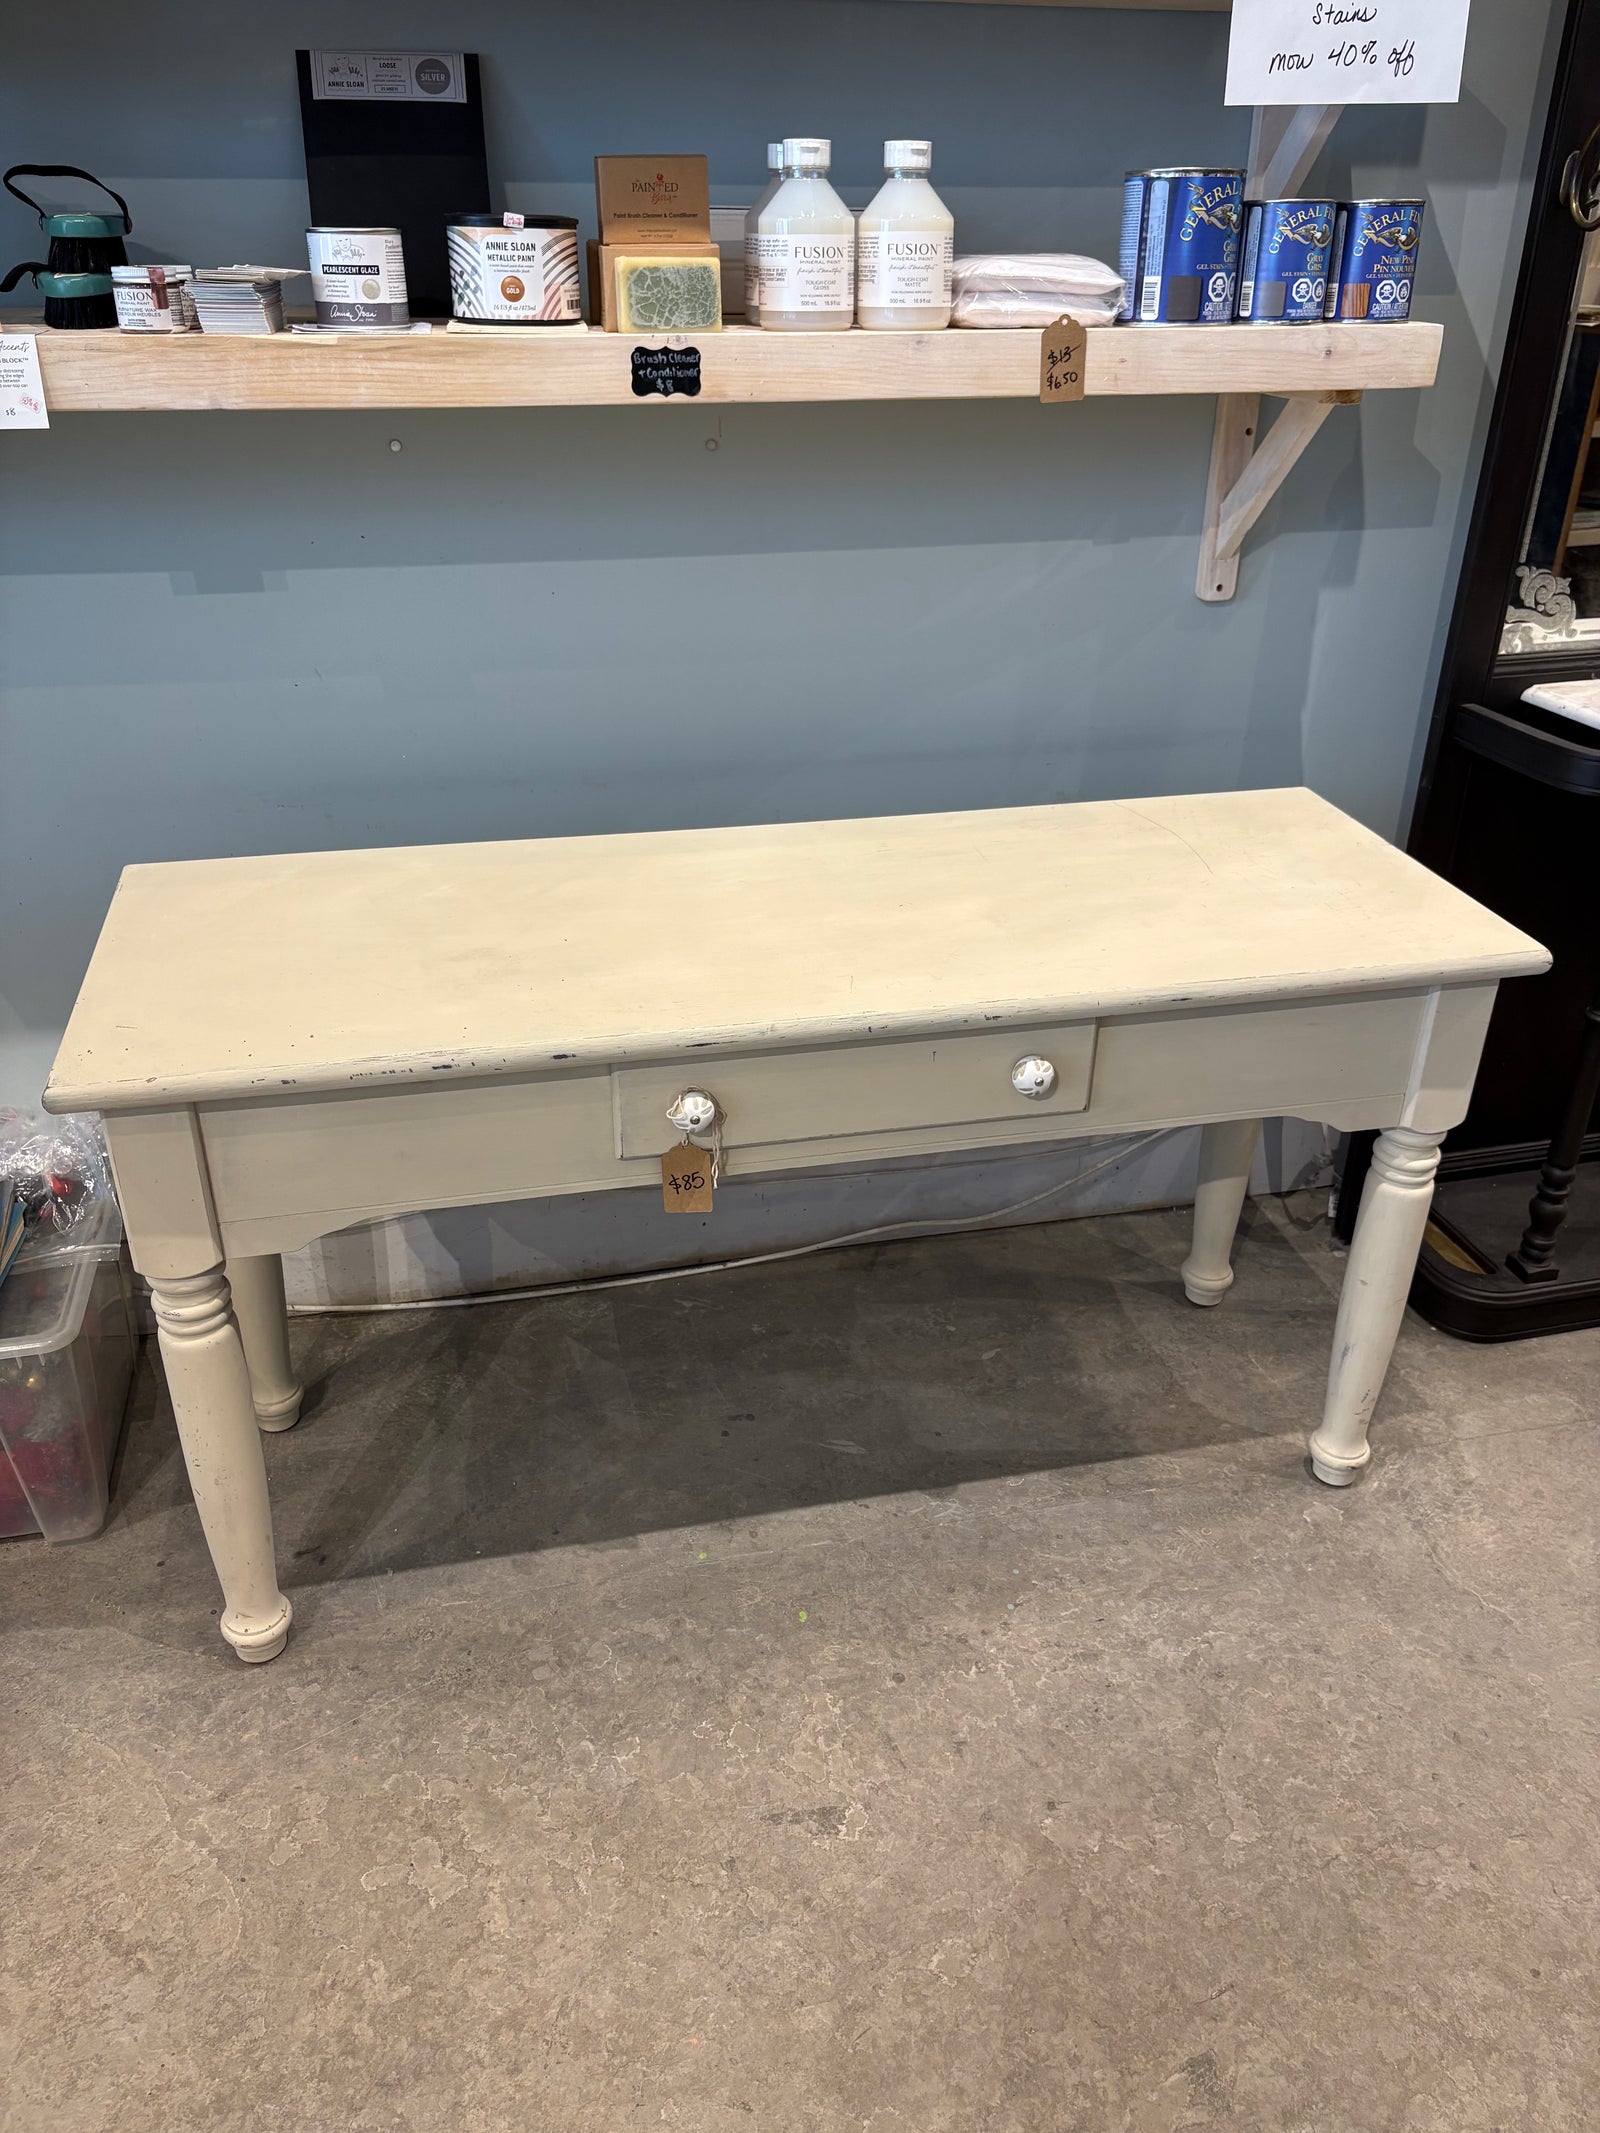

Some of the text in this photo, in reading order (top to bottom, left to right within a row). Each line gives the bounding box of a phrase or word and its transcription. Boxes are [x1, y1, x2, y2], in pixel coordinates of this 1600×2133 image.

[1312, 3, 1377, 25] Stains
[1328, 41, 1377, 67] 40%
[1387, 39, 1415, 77] off
[421, 73, 446, 81] SILVER
[1180, 181, 1239, 242] GENERAL
[1268, 205, 1322, 254] GENERAL
[1353, 209, 1407, 257] GENERAL
[485, 241, 536, 252] ANNIE SLOAN
[487, 254, 535, 262] METALLIC PAINT
[323, 265, 379, 274] PEARLESCENT GLAZE
[1373, 264, 1389, 273] PIN
[116, 291, 154, 301] FUSION
[633, 352, 700, 364] Brush Cleaner
[668, 1171, 705, 1195] $85
